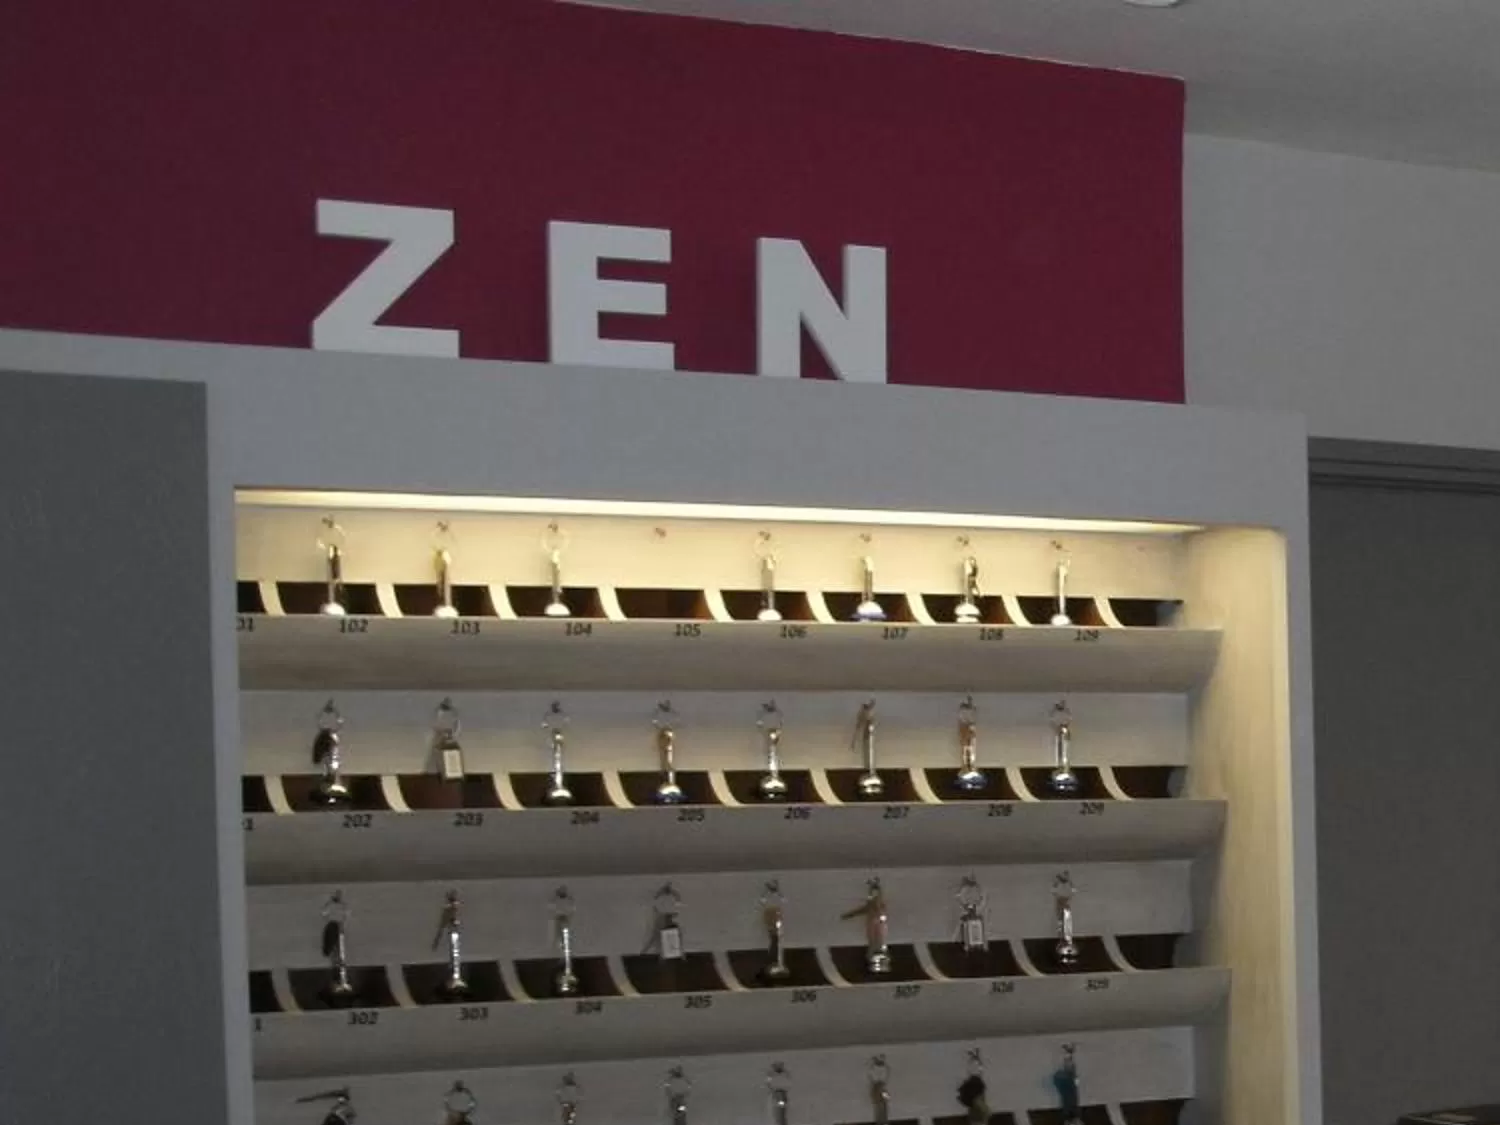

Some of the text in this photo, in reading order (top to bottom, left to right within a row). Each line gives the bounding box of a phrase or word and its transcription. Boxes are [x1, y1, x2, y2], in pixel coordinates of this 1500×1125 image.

[311, 198, 888, 384] ZEN
[339, 618, 368, 633] 102
[452, 620, 480, 635] 103
[565, 622, 593, 636] 104
[674, 623, 700, 637] 105
[780, 624, 806, 639] 106
[882, 626, 908, 640] 107
[979, 627, 1004, 641] 108
[1073, 628, 1099, 642] 109
[342, 813, 372, 830] 202
[454, 812, 484, 827] 203
[570, 811, 600, 825] 204
[678, 808, 706, 823] 205
[784, 806, 811, 821] 206
[882, 805, 910, 820] 207
[348, 1011, 379, 1026] 302
[459, 1006, 489, 1022] 303
